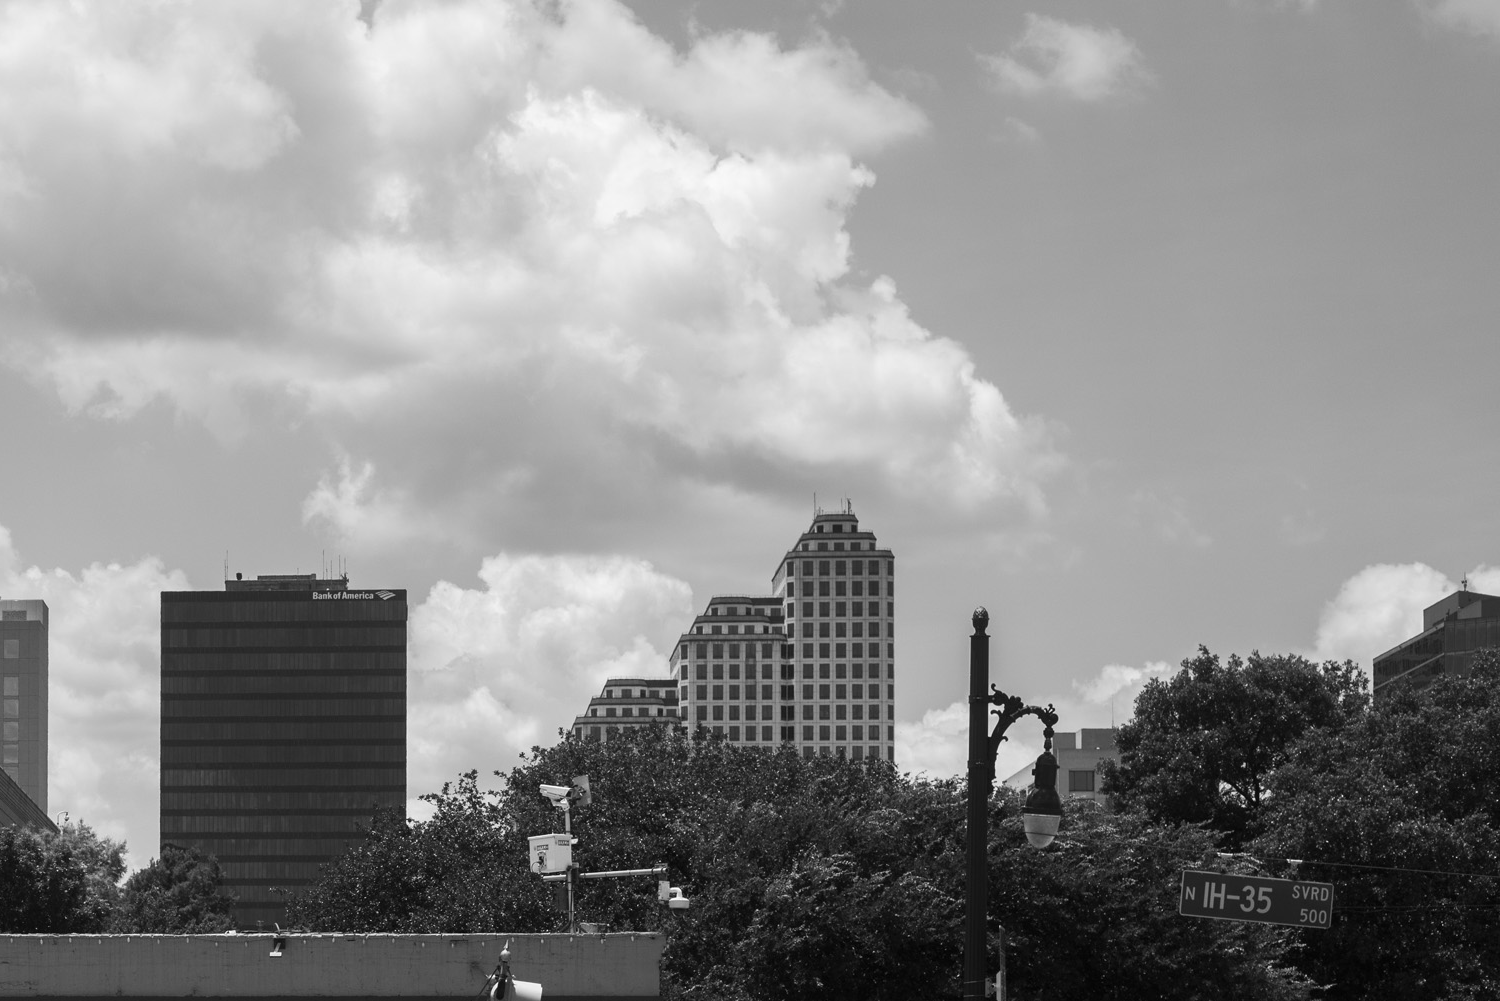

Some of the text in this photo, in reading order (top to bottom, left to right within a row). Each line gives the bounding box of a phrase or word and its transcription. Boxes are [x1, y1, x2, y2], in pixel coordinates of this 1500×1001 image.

[312, 592, 374, 600] Bank of America
[1185, 881, 1273, 914] N IH-35
[1291, 884, 1329, 902] SVRD
[1299, 908, 1327, 924] 500
